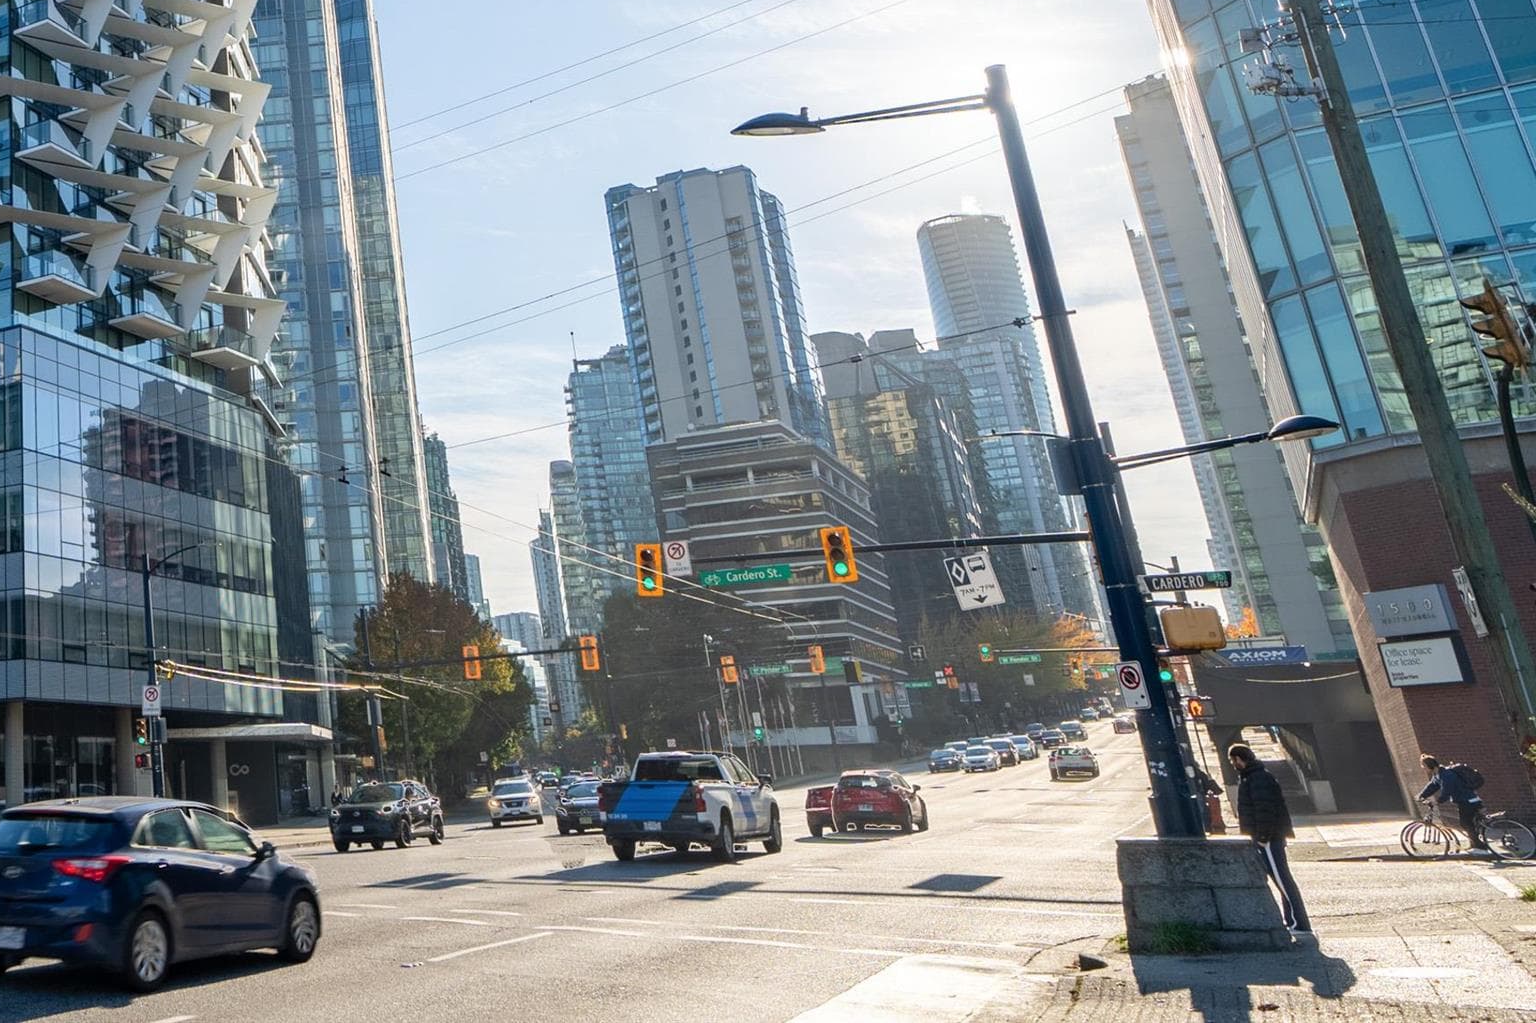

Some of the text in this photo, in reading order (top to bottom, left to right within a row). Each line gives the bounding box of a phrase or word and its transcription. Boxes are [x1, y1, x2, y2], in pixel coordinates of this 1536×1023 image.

[726, 567, 782, 582] Cardero St.
[1151, 575, 1205, 591] CARDERO
[1376, 598, 1433, 615] 1500
[1228, 650, 1287, 660] AXIOM
